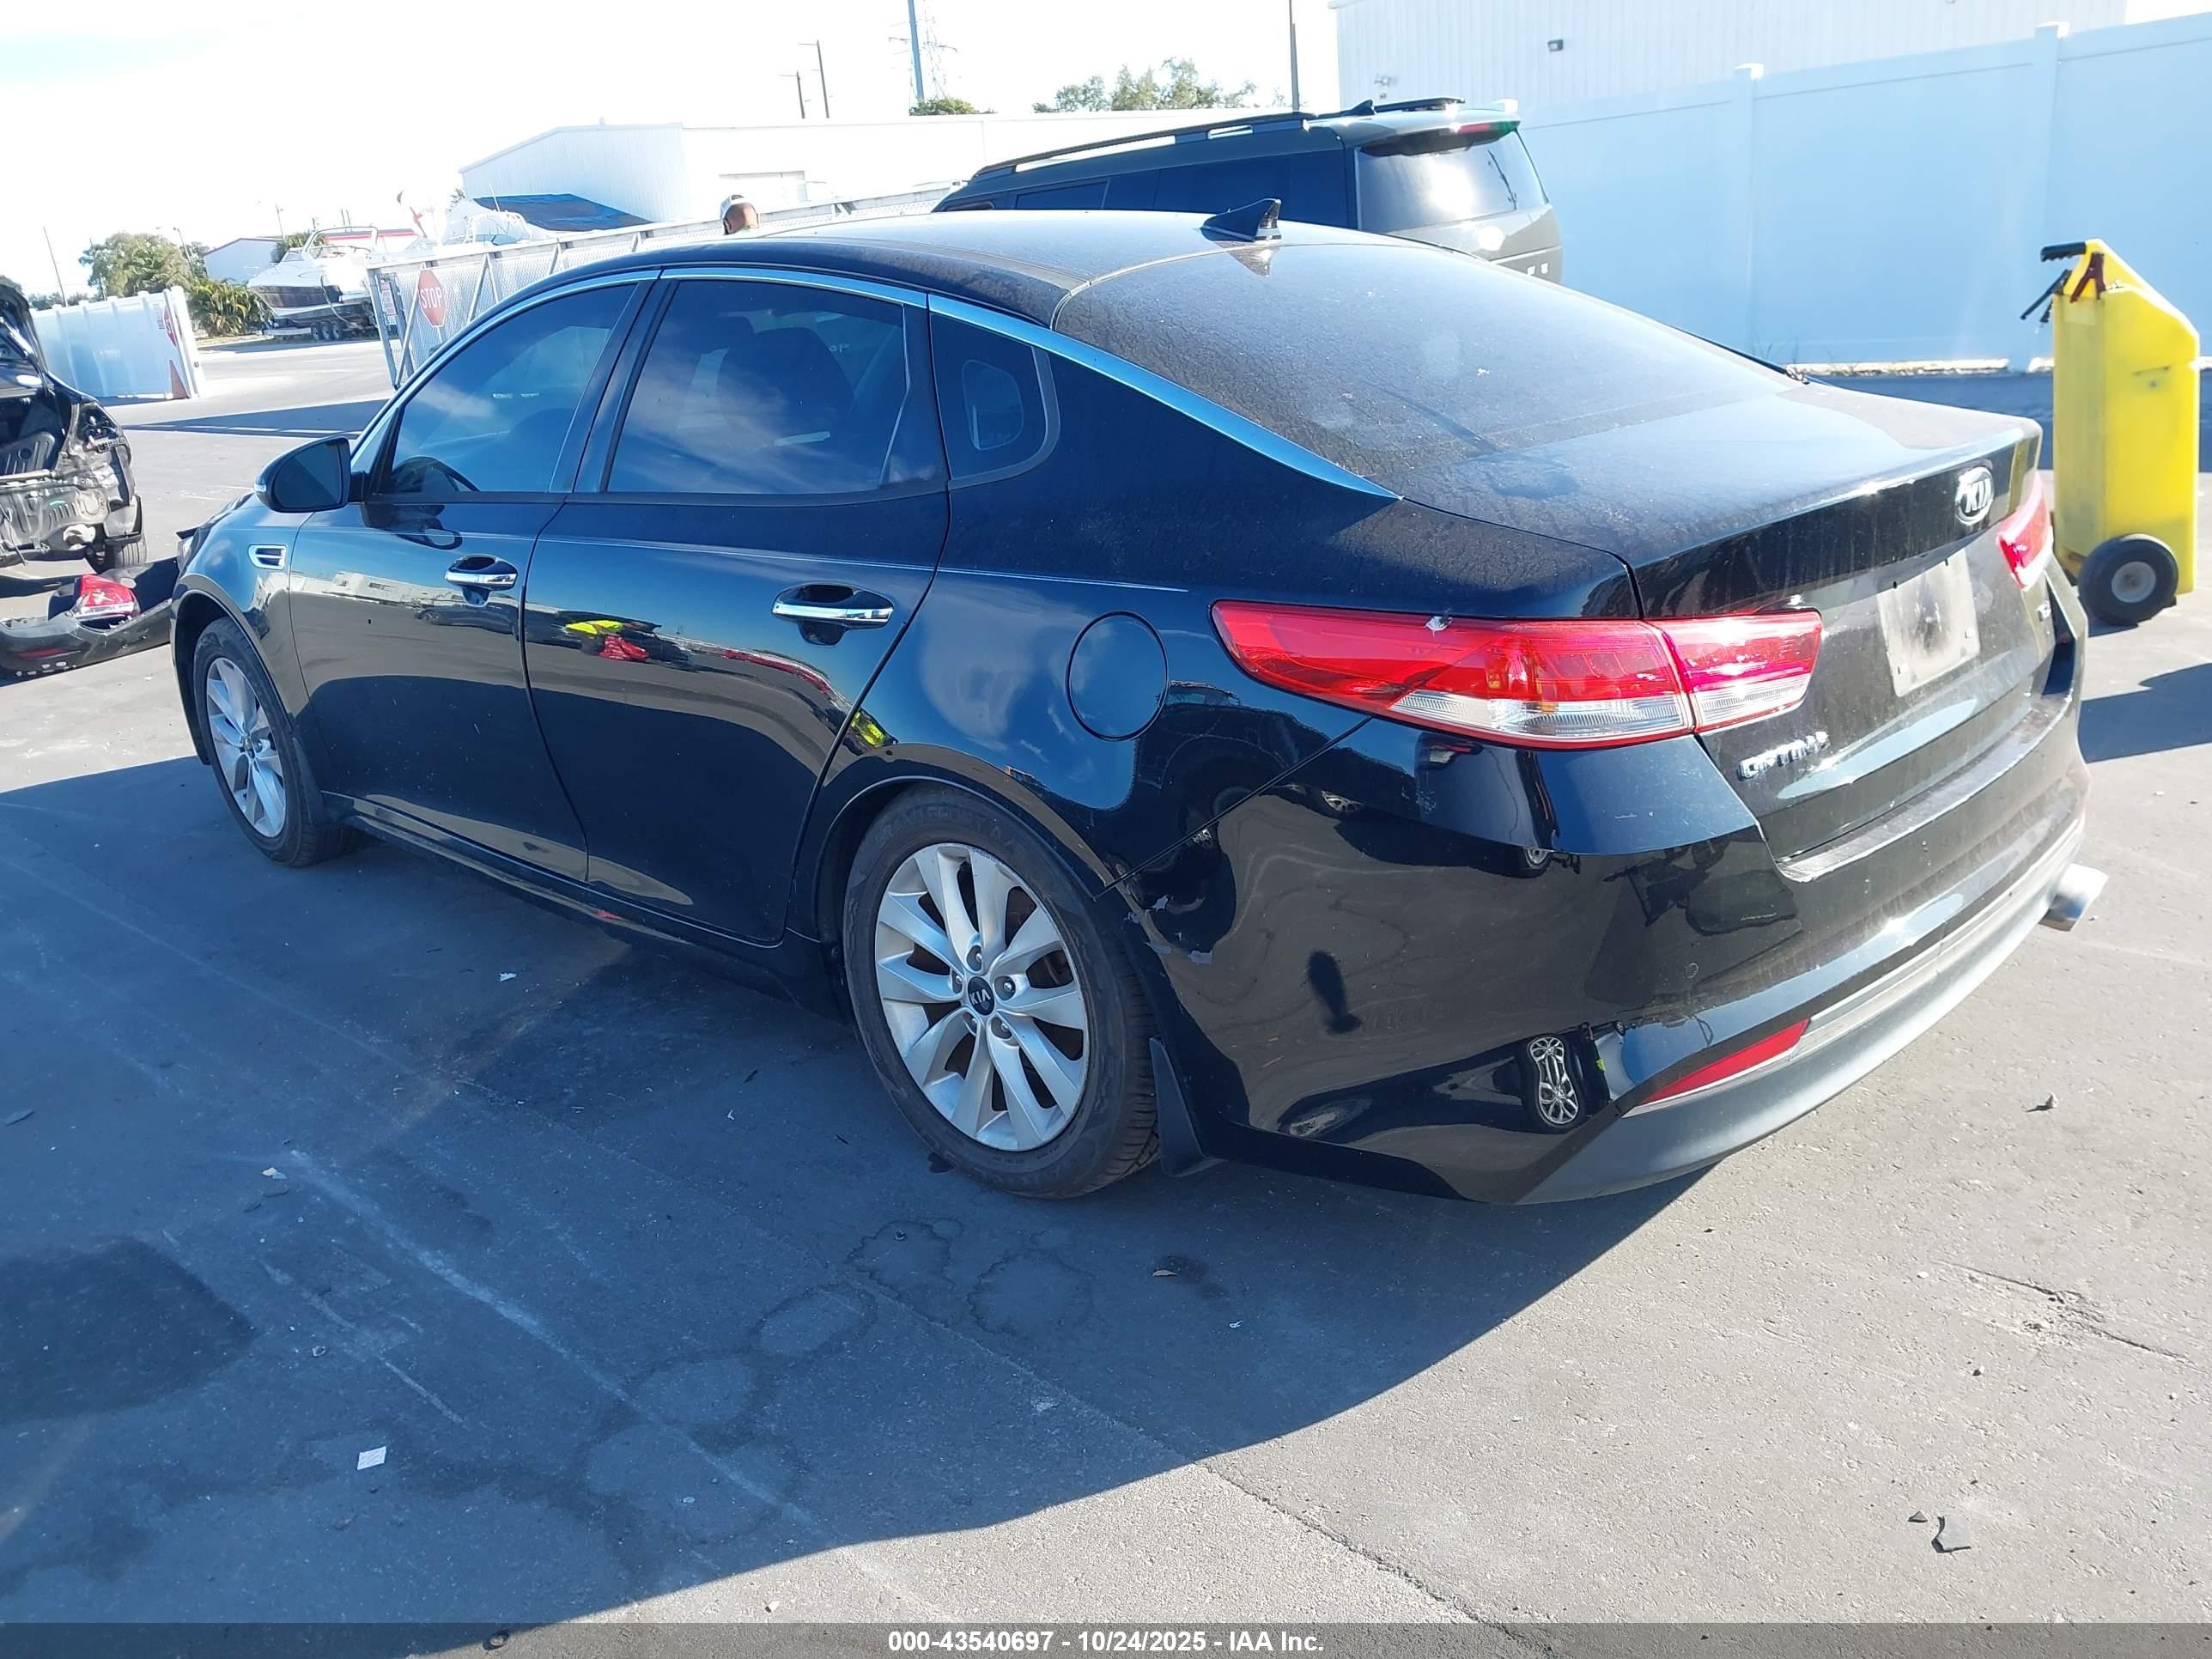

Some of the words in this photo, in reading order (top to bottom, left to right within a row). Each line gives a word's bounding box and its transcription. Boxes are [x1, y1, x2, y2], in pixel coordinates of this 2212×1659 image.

[420, 287, 443, 309] STOP
[1965, 477, 1992, 514] KIA
[969, 989, 992, 1006] KIA
